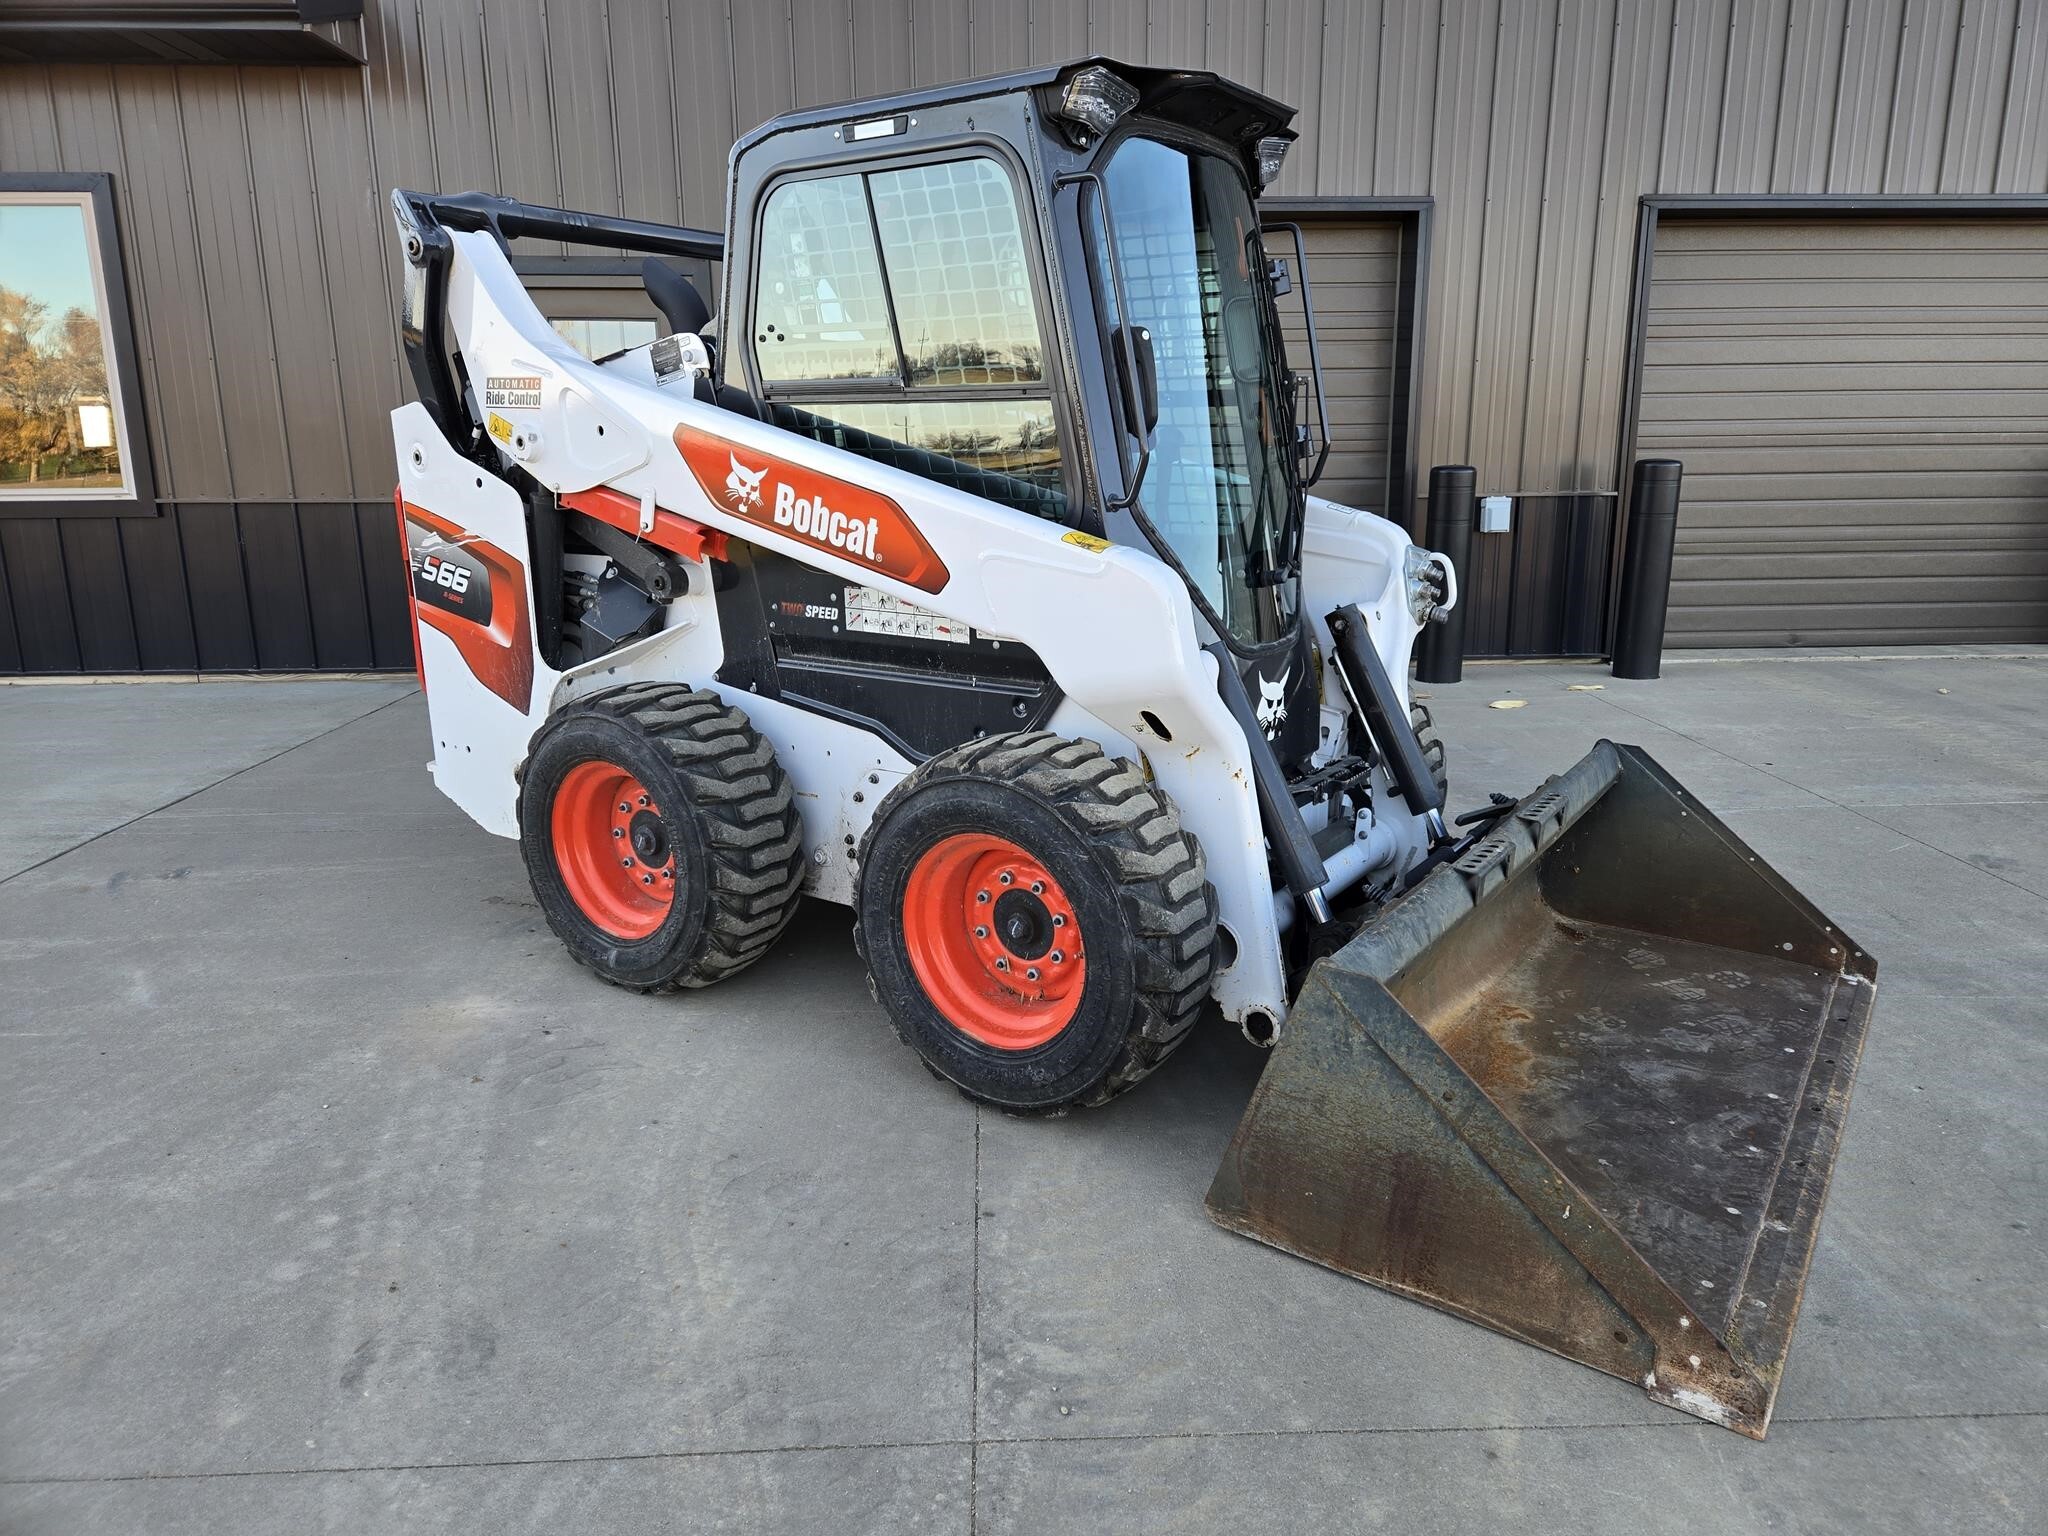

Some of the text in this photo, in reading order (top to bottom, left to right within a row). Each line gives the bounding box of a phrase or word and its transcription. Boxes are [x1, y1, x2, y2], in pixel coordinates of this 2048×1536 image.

[487, 378, 540, 389] AUTOMATIC
[486, 391, 541, 406] Ride Control
[774, 482, 879, 561] Bobcat
[421, 556, 471, 594] S66
[781, 601, 839, 620] TWO SPEED
